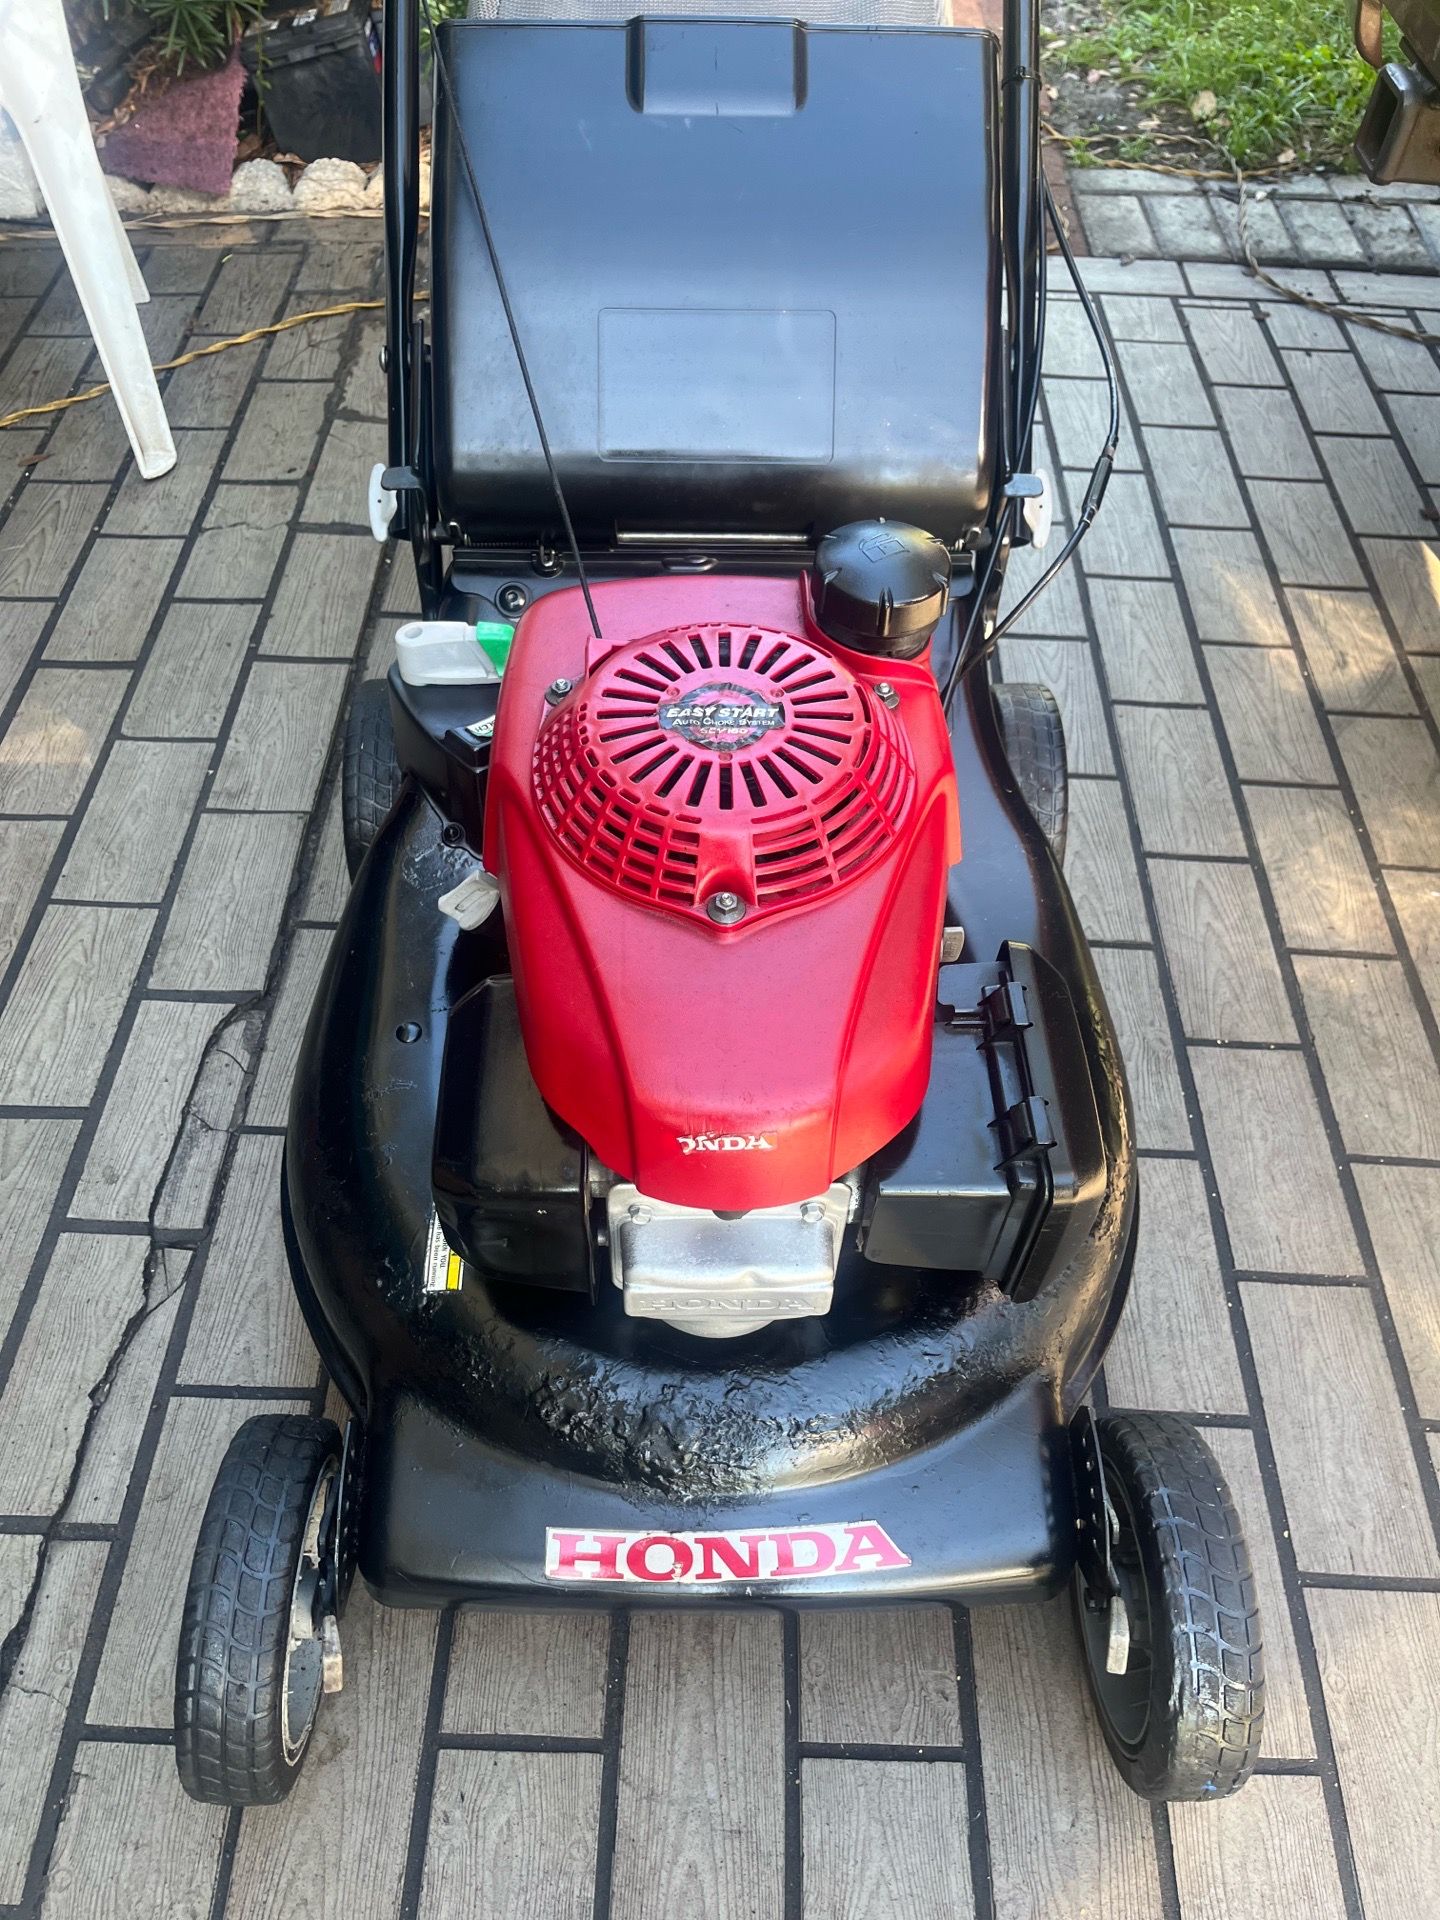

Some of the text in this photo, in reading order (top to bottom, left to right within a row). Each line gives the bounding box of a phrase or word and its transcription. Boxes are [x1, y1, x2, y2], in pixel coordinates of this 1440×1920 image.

[666, 706, 779, 718] EASY START
[640, 1299, 815, 1311] HONDA
[552, 1525, 909, 1581] HONDA
